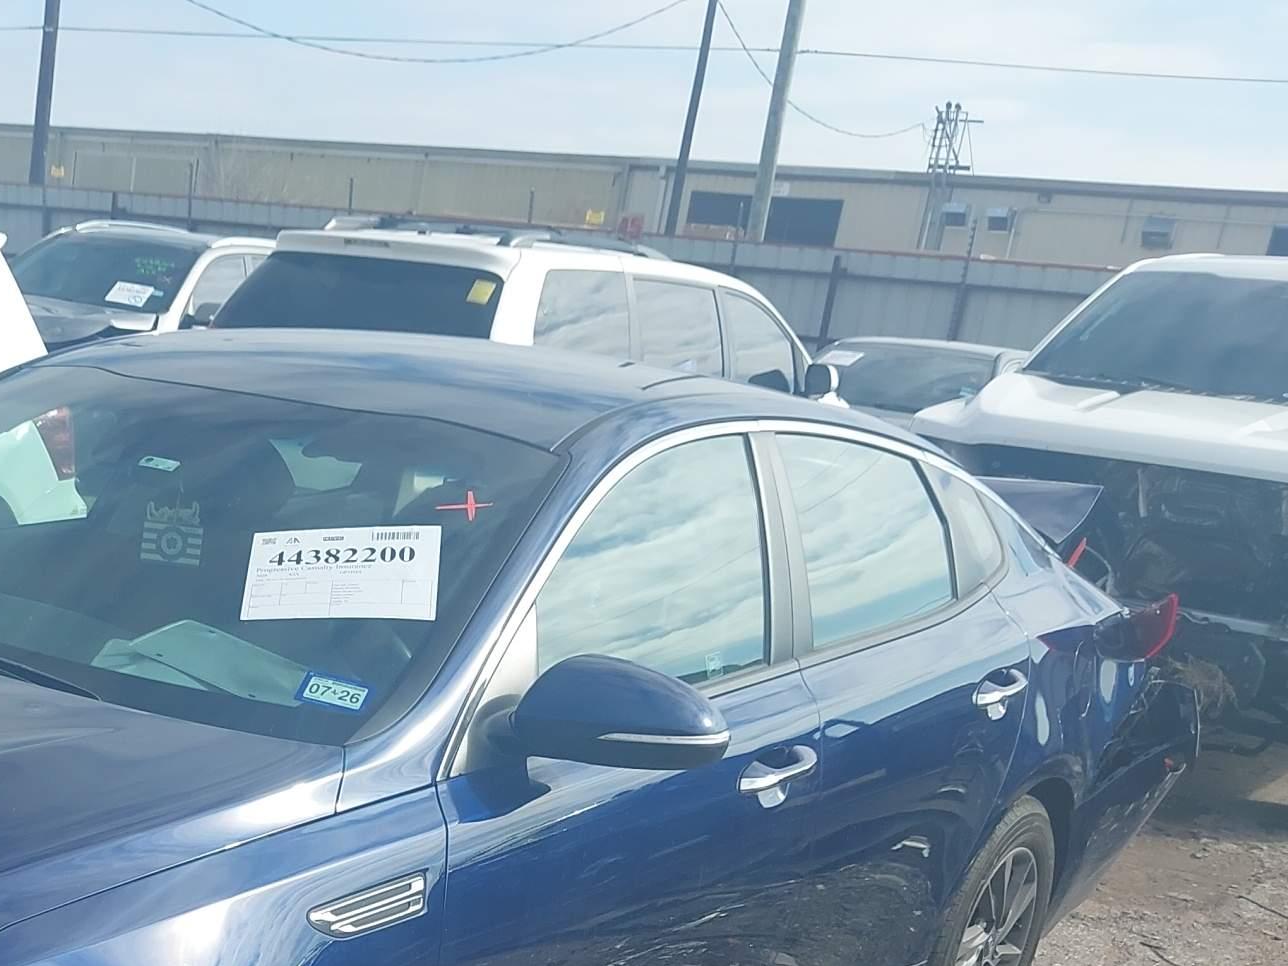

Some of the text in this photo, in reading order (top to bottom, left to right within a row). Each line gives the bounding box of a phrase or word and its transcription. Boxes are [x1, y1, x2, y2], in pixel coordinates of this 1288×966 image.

[269, 545, 416, 566] 44382200
[308, 683, 362, 704] 07 26
